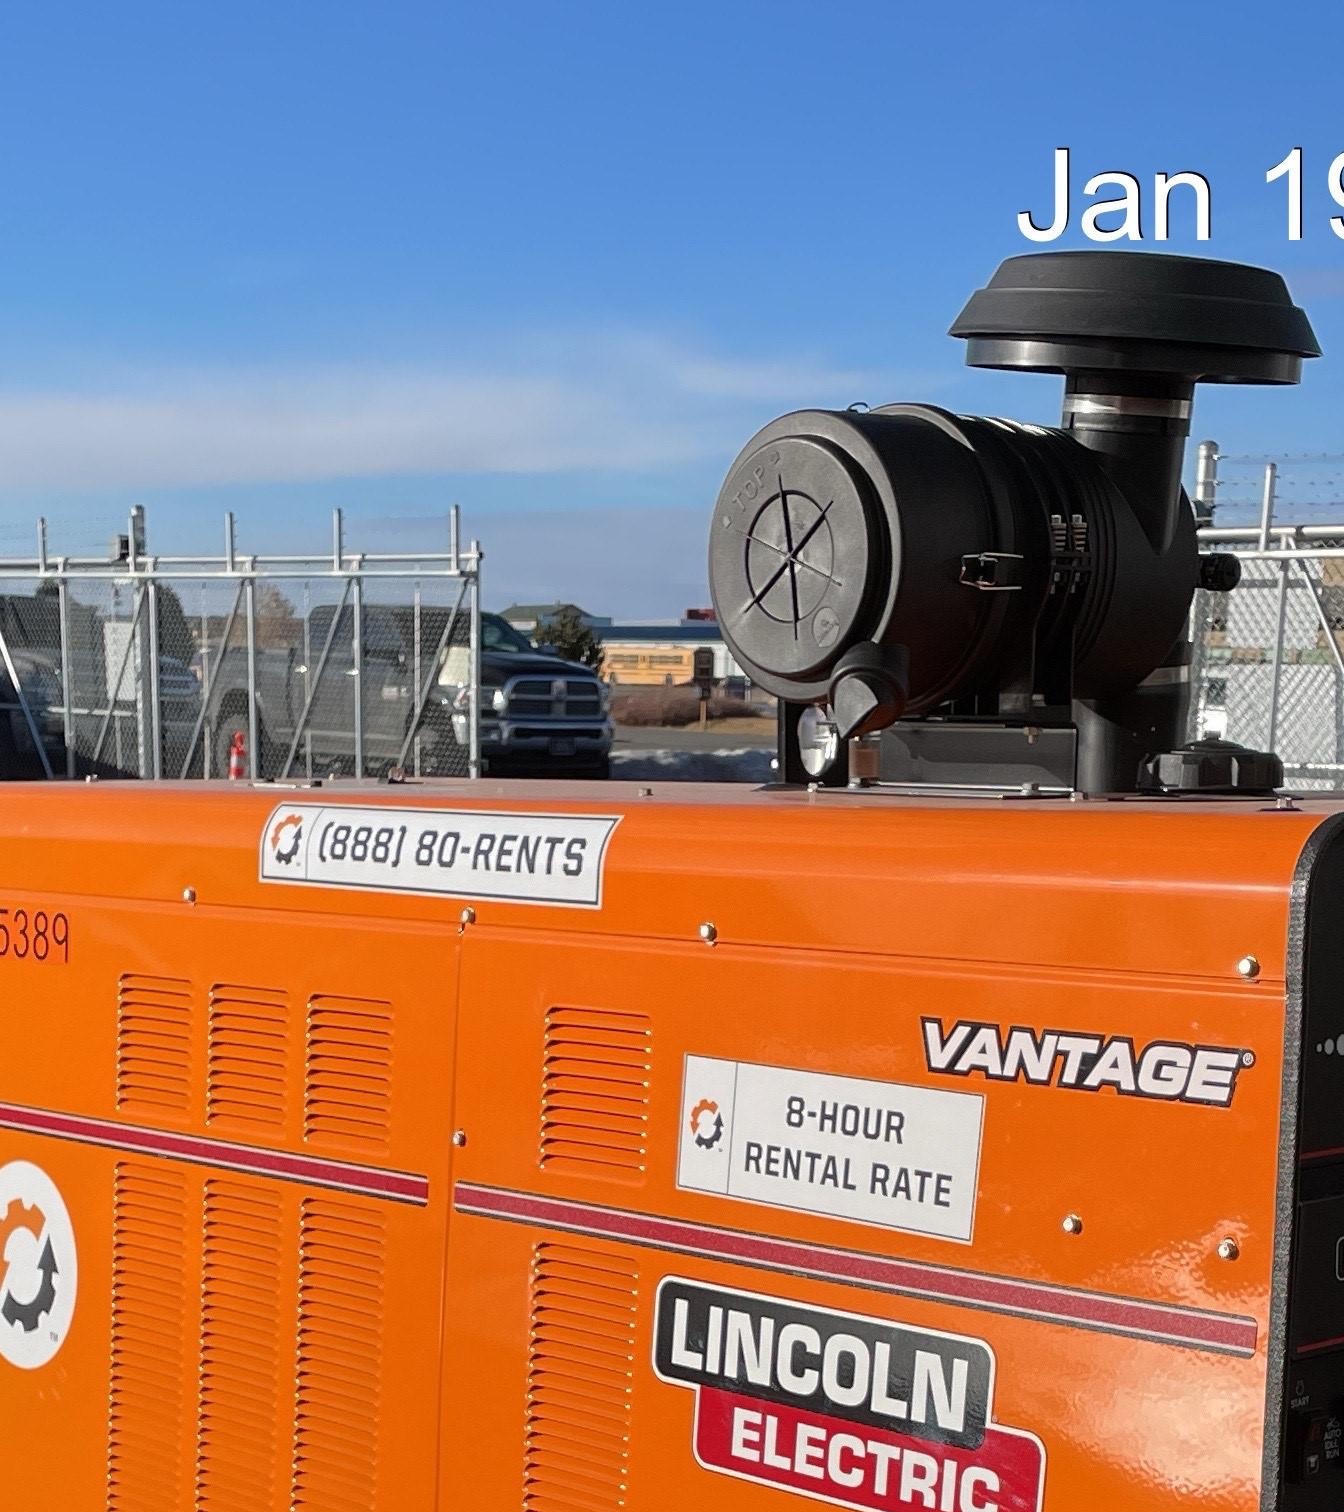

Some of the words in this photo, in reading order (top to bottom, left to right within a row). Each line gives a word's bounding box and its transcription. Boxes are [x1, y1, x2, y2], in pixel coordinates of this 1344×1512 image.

[732, 464, 766, 513] TOP
[318, 820, 401, 867] (888)
[413, 827, 589, 878] 80-RENTS
[922, 1018, 1240, 1105] VANTAGE
[785, 1094, 906, 1146] 8-HOUR
[744, 1141, 859, 1191] RENTAL
[869, 1161, 954, 1208] RATE
[669, 1296, 971, 1434] LINCOLN
